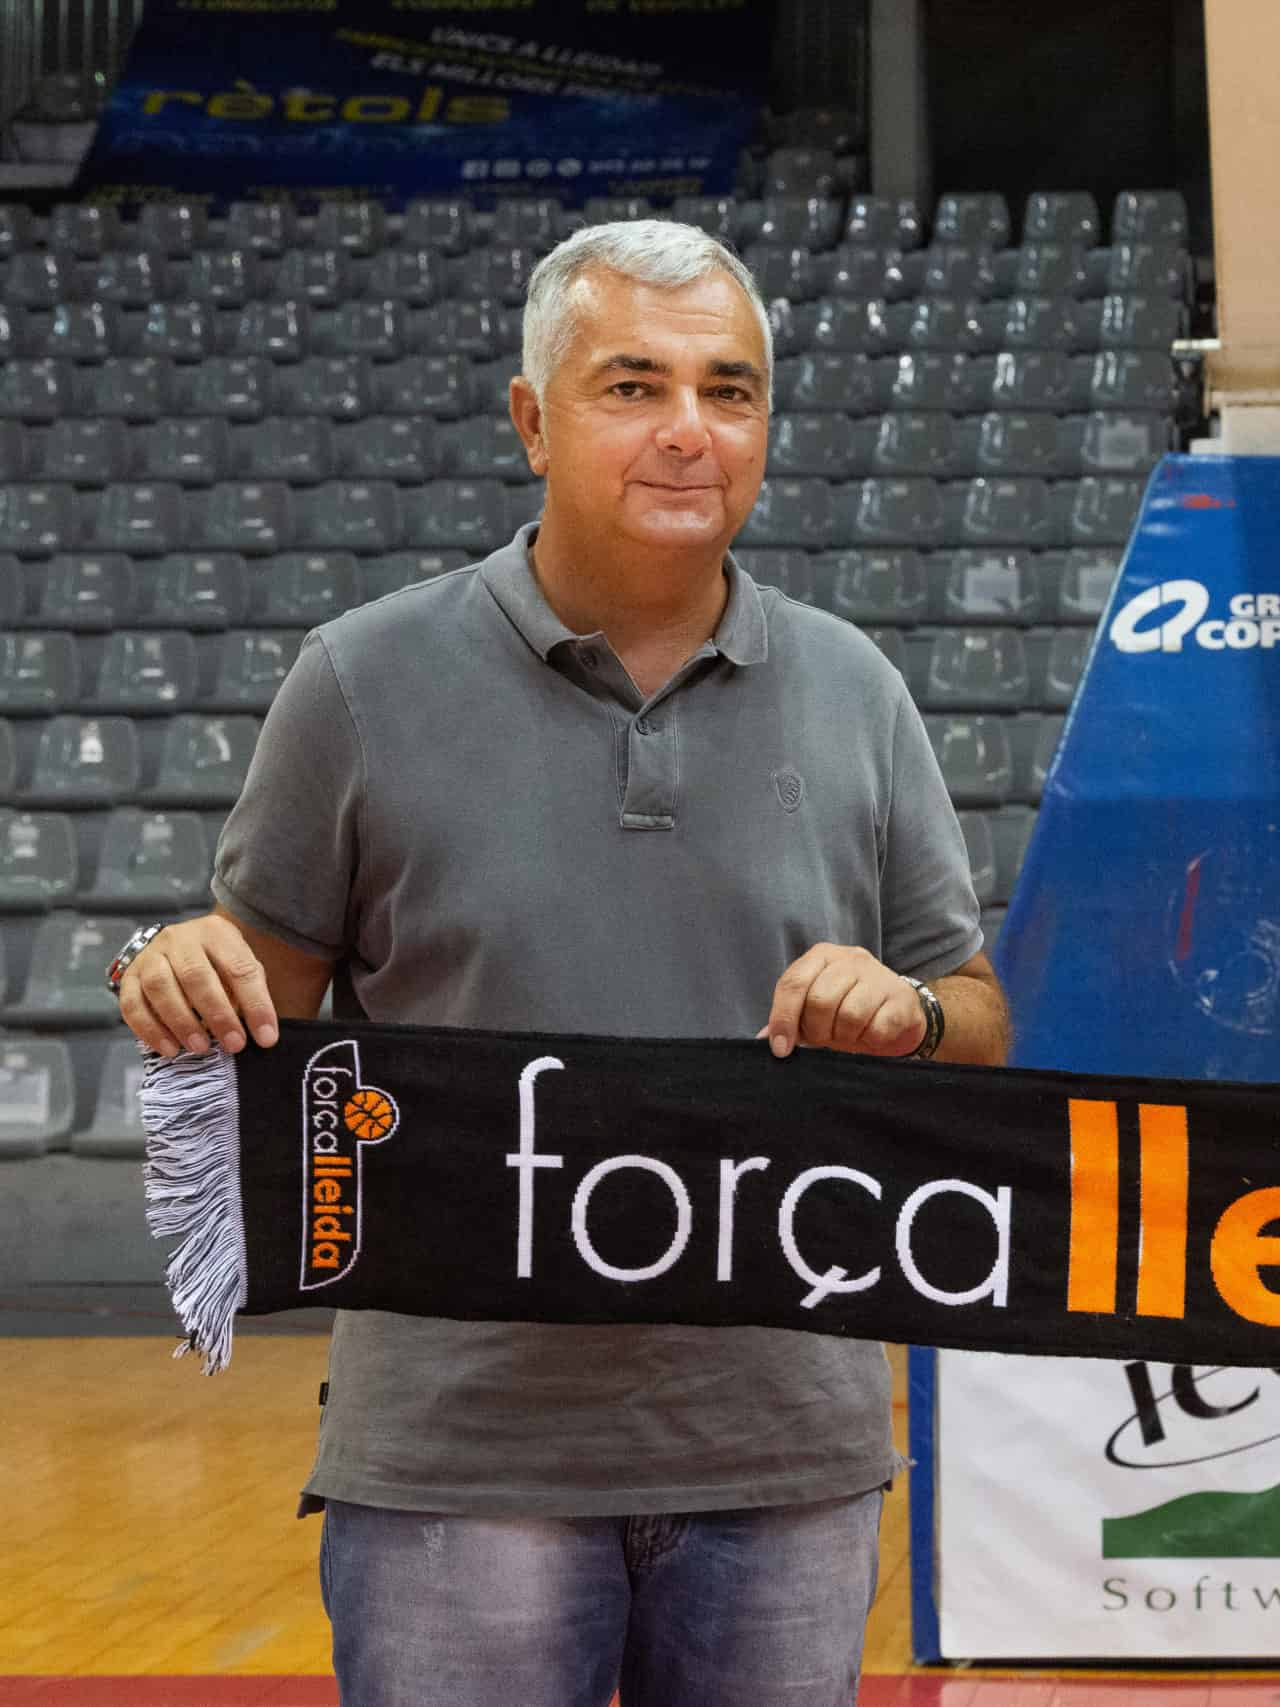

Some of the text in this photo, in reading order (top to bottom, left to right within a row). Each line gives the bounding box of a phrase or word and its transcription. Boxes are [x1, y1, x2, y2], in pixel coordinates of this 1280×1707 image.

[312, 1067, 354, 1269] força lleida
[506, 1056, 1011, 1308] força
